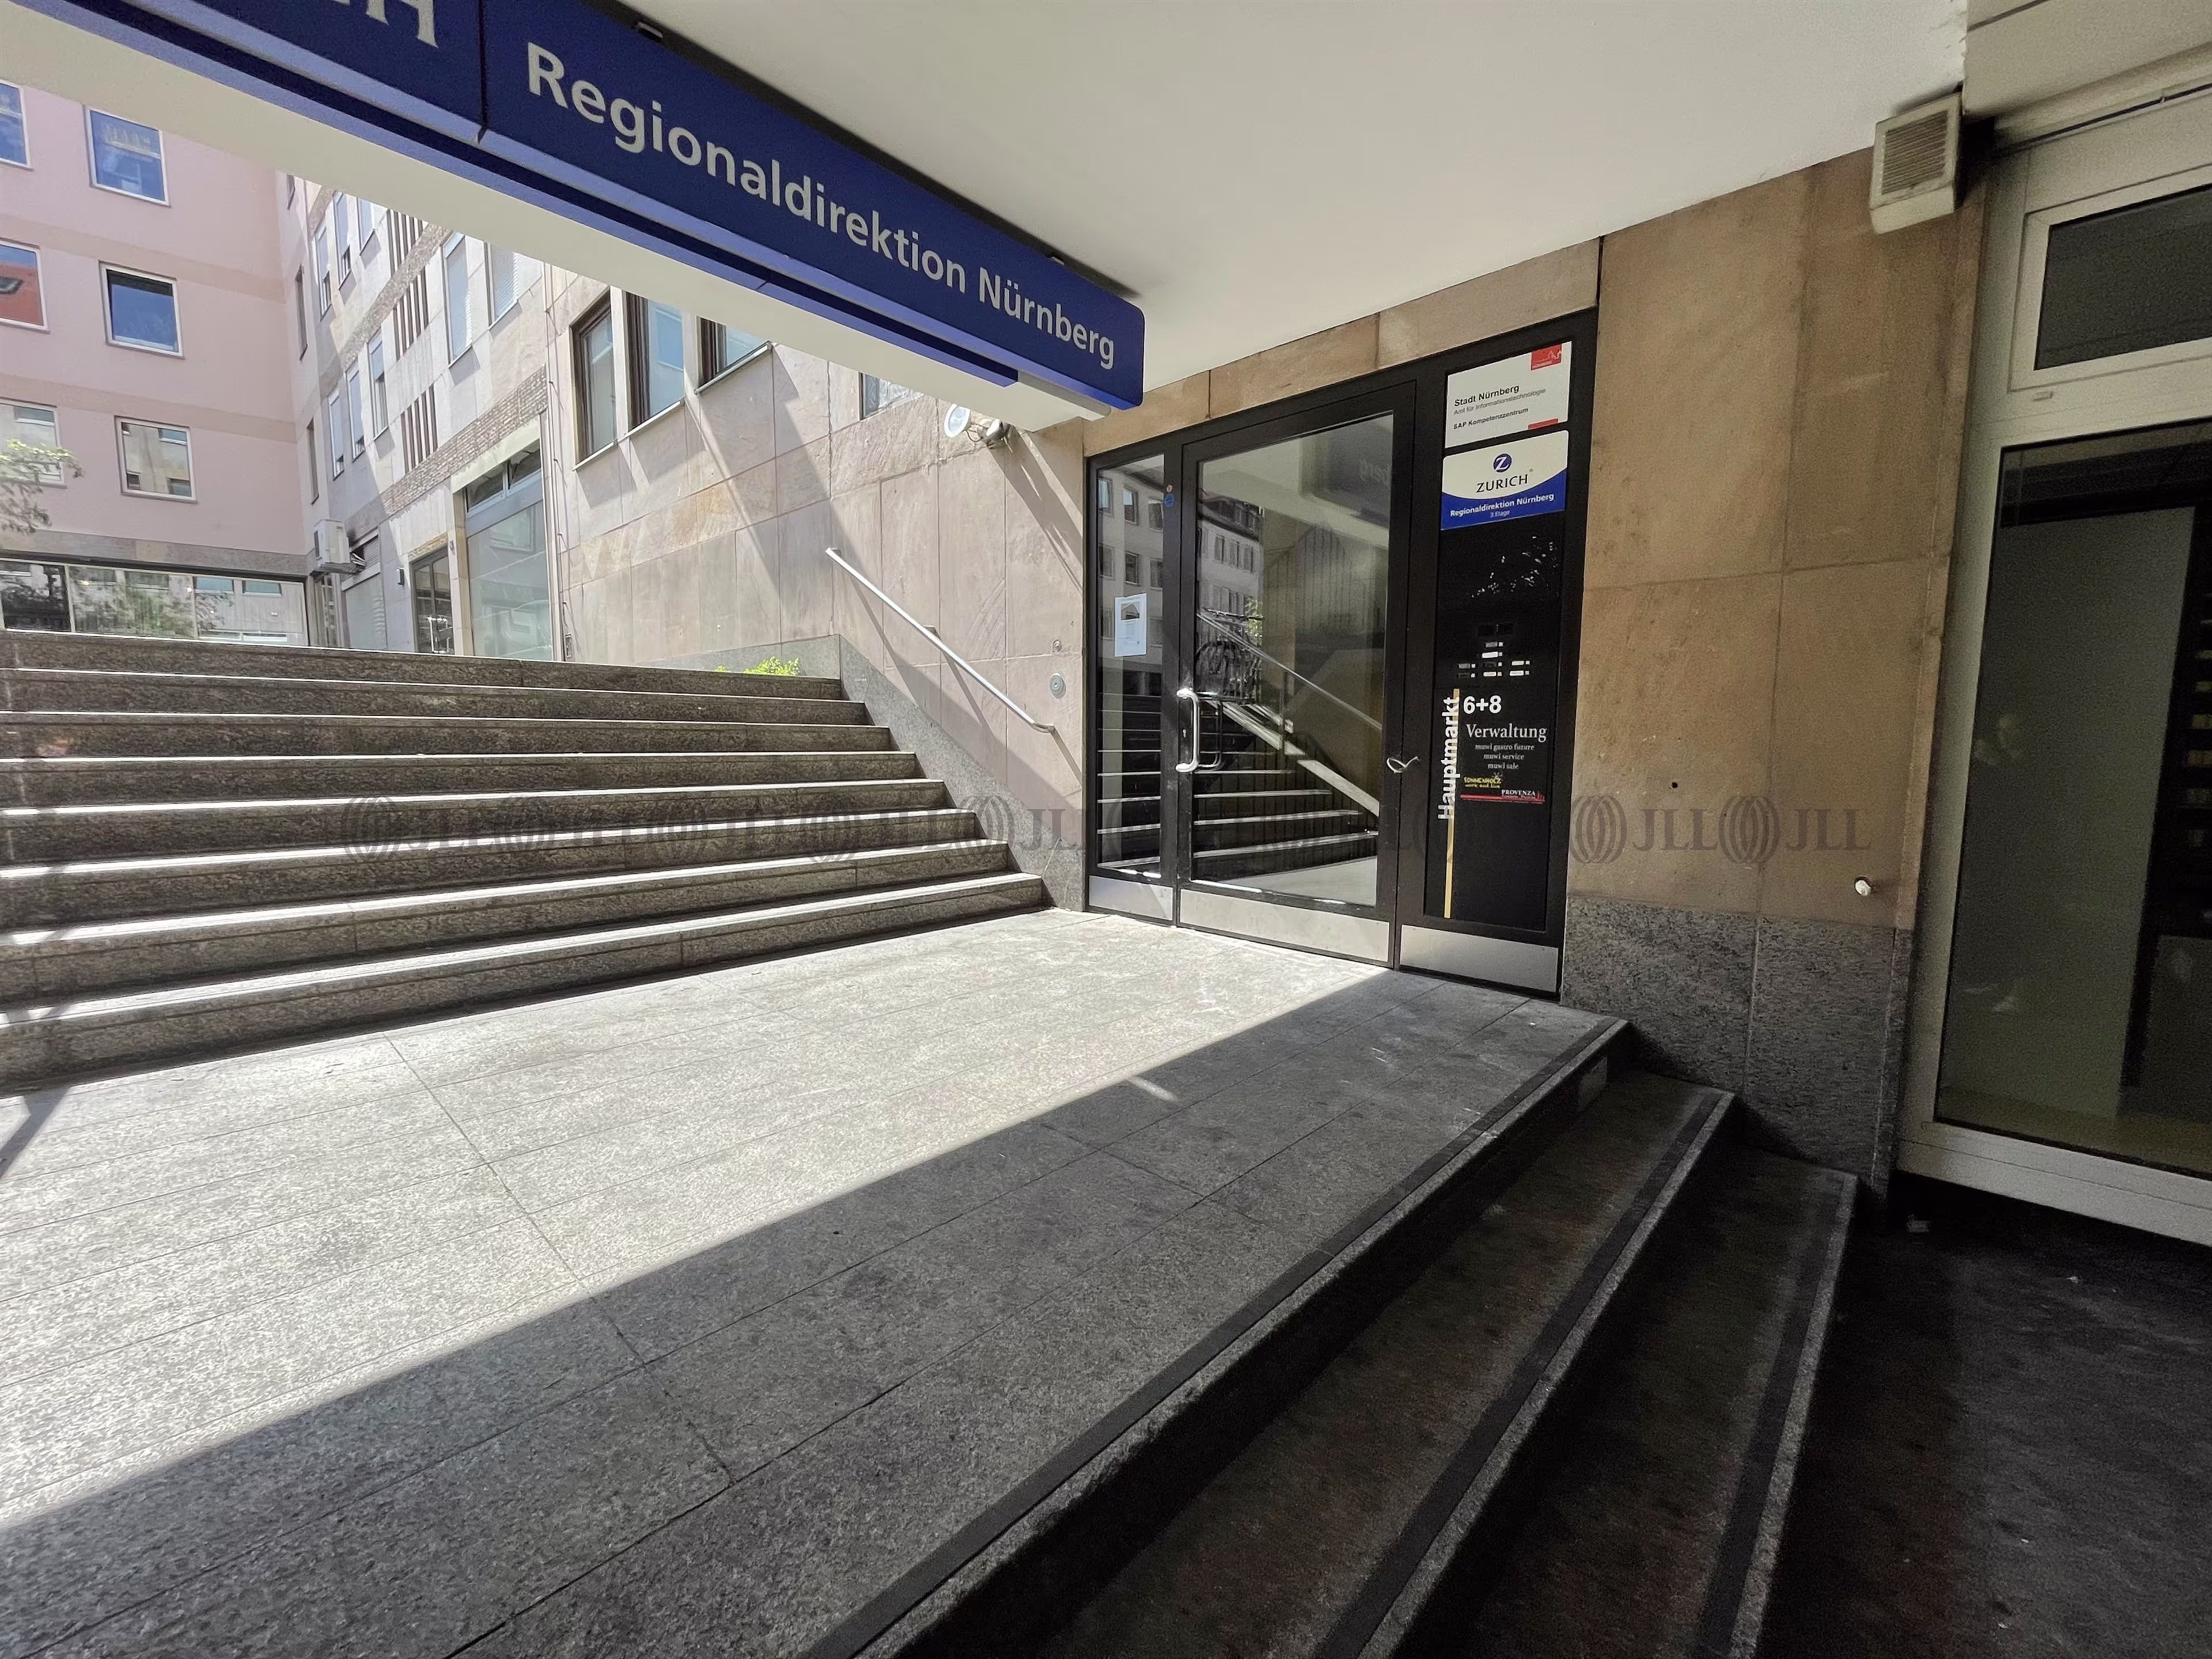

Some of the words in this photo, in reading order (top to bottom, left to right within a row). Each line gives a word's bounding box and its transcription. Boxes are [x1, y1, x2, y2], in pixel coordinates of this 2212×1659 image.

[527, 41, 966, 294] Regionaldirektion
[979, 267, 1114, 370] Nürnberg
[1455, 396, 1476, 407] Stadt
[1479, 385, 1520, 401] Nürnberg
[1475, 388, 1546, 410] Informationstechnologie
[1453, 422, 1467, 430] SAP
[1468, 408, 1528, 426] Kompetenzzentrum
[1476, 474, 1528, 493] ZURICH
[1450, 500, 1515, 517] Regionaldirektion
[1516, 493, 1554, 506] Nürnberg
[1463, 695, 1502, 714] 6+8
[1465, 722, 1547, 743] Verwaltung
[1437, 696, 1460, 820] Hauptmarkt
